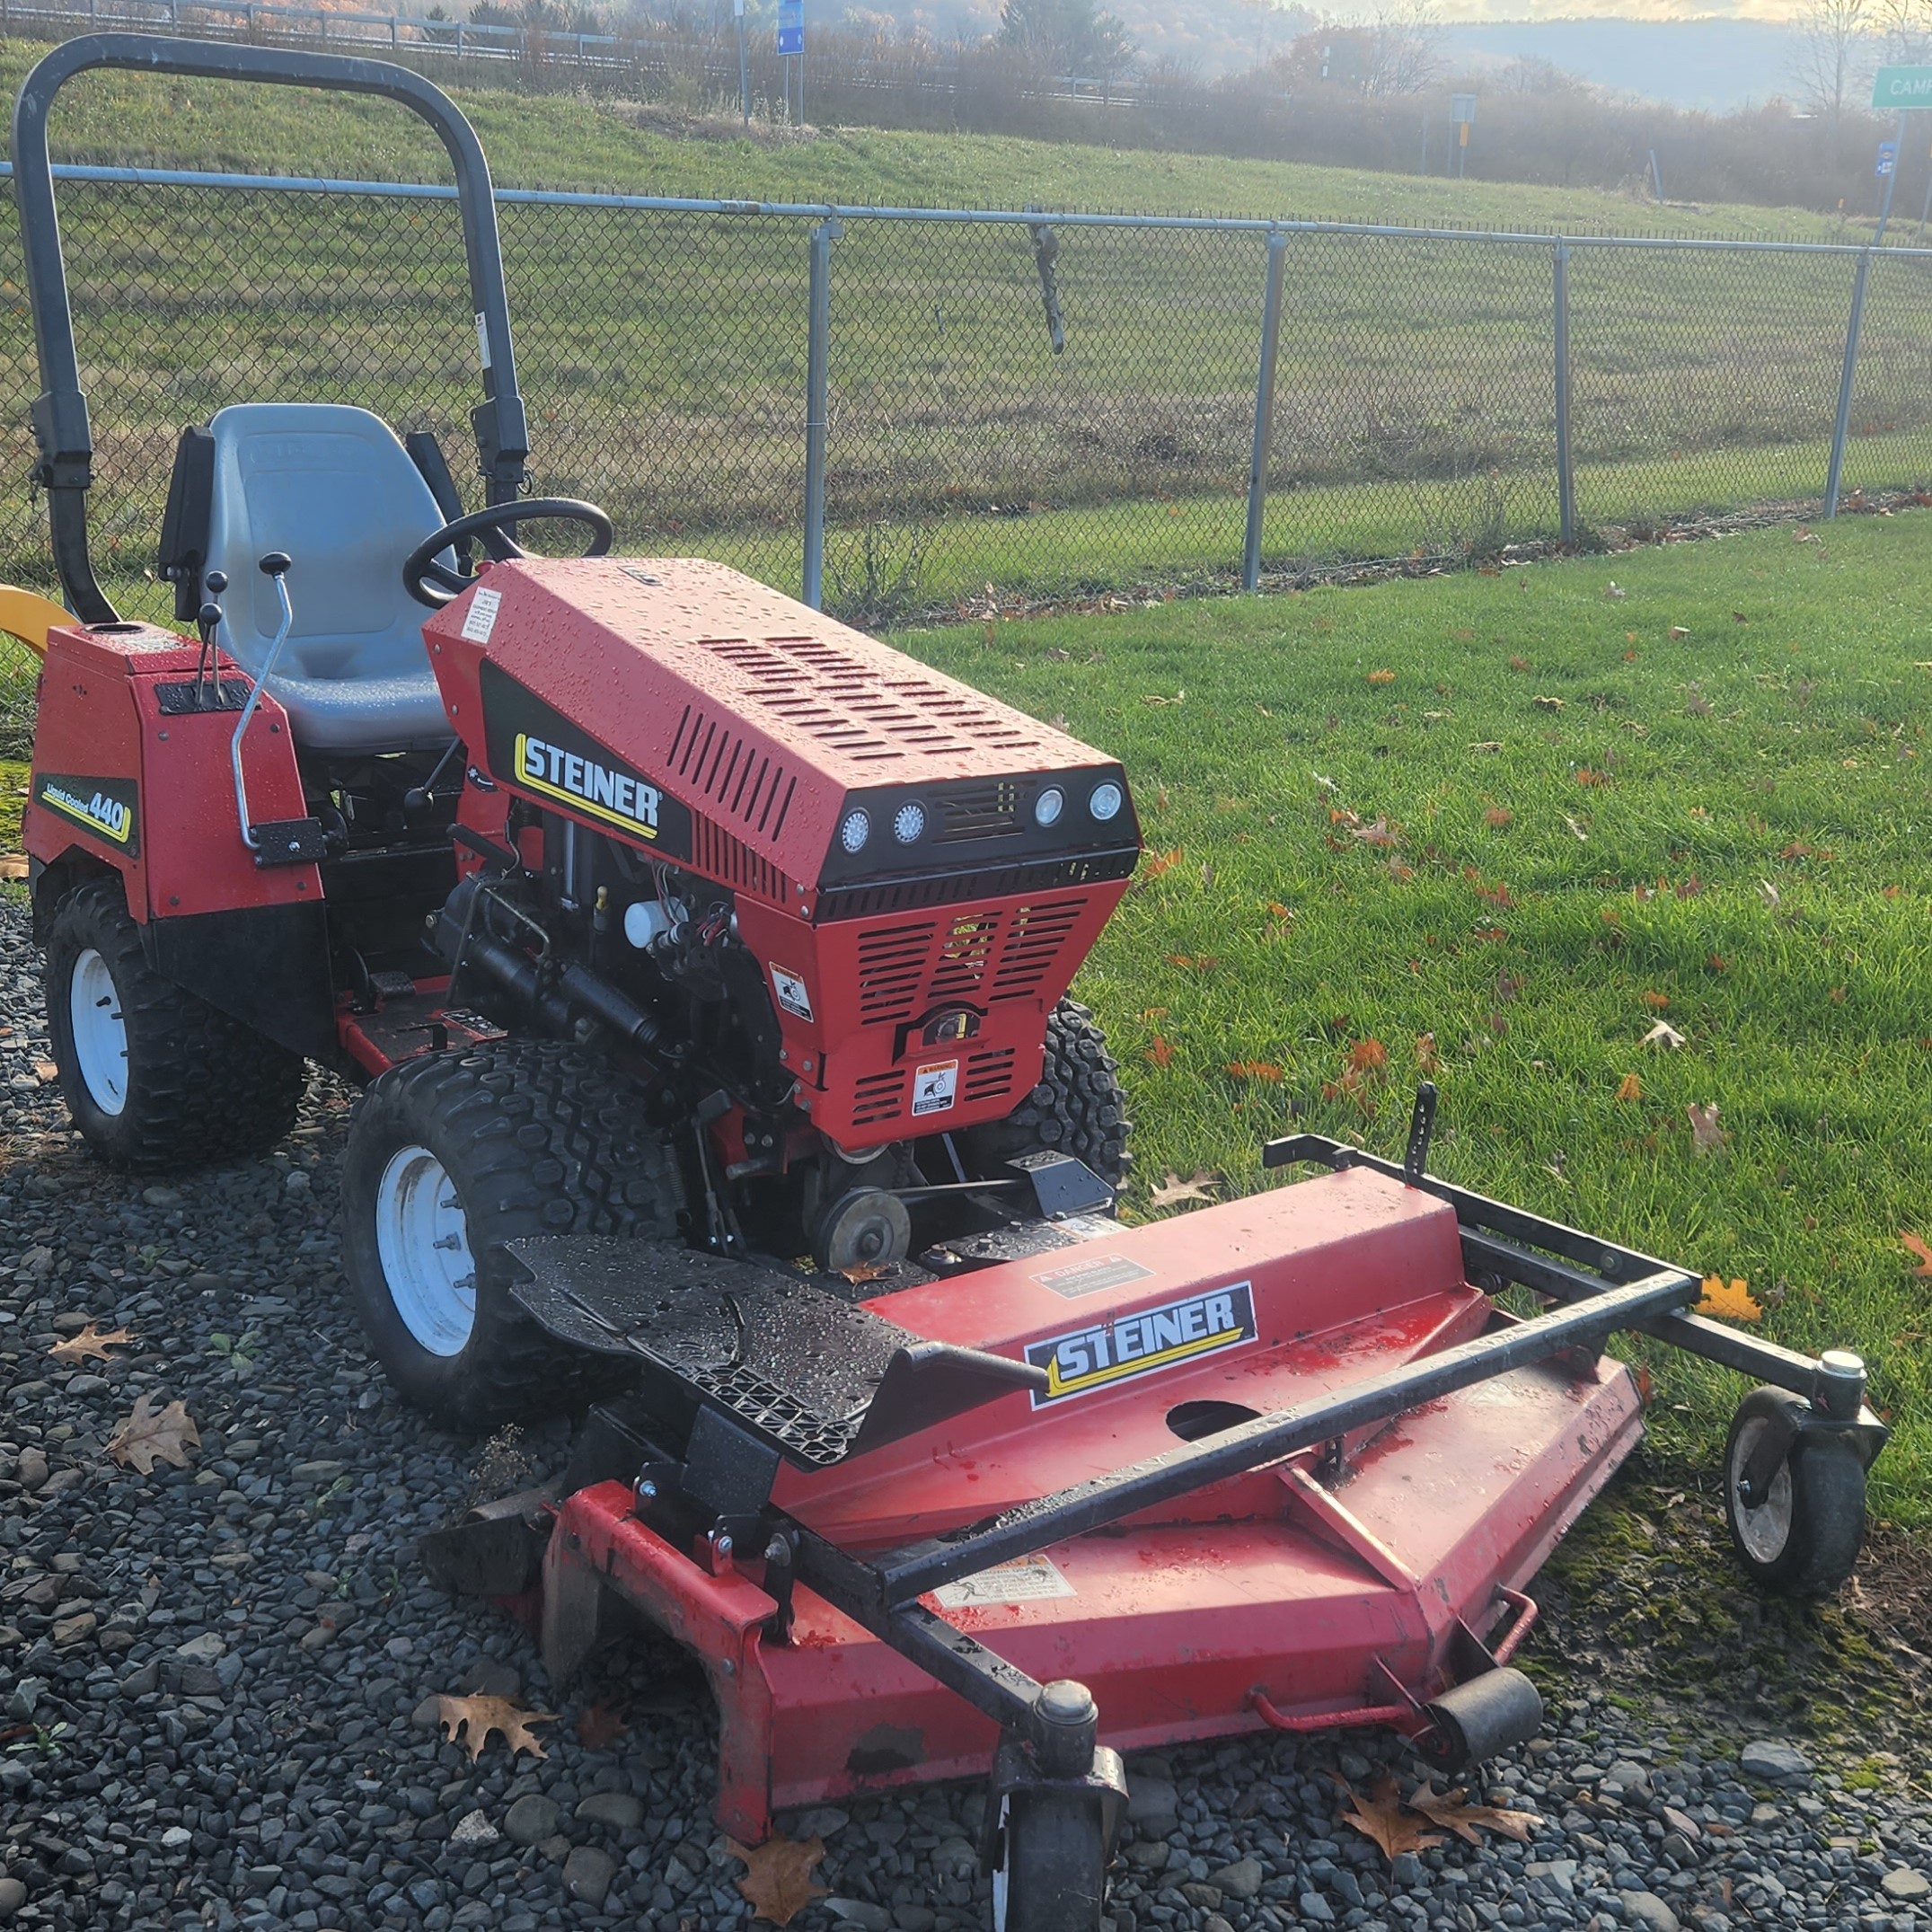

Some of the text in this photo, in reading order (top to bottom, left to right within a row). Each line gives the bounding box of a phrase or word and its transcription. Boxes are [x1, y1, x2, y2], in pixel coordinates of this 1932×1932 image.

[46, 782, 124, 831] Liquid Cooled 440
[1054, 1260, 1105, 1277] DANGER
[1056, 1293, 1236, 1381] STEINER
